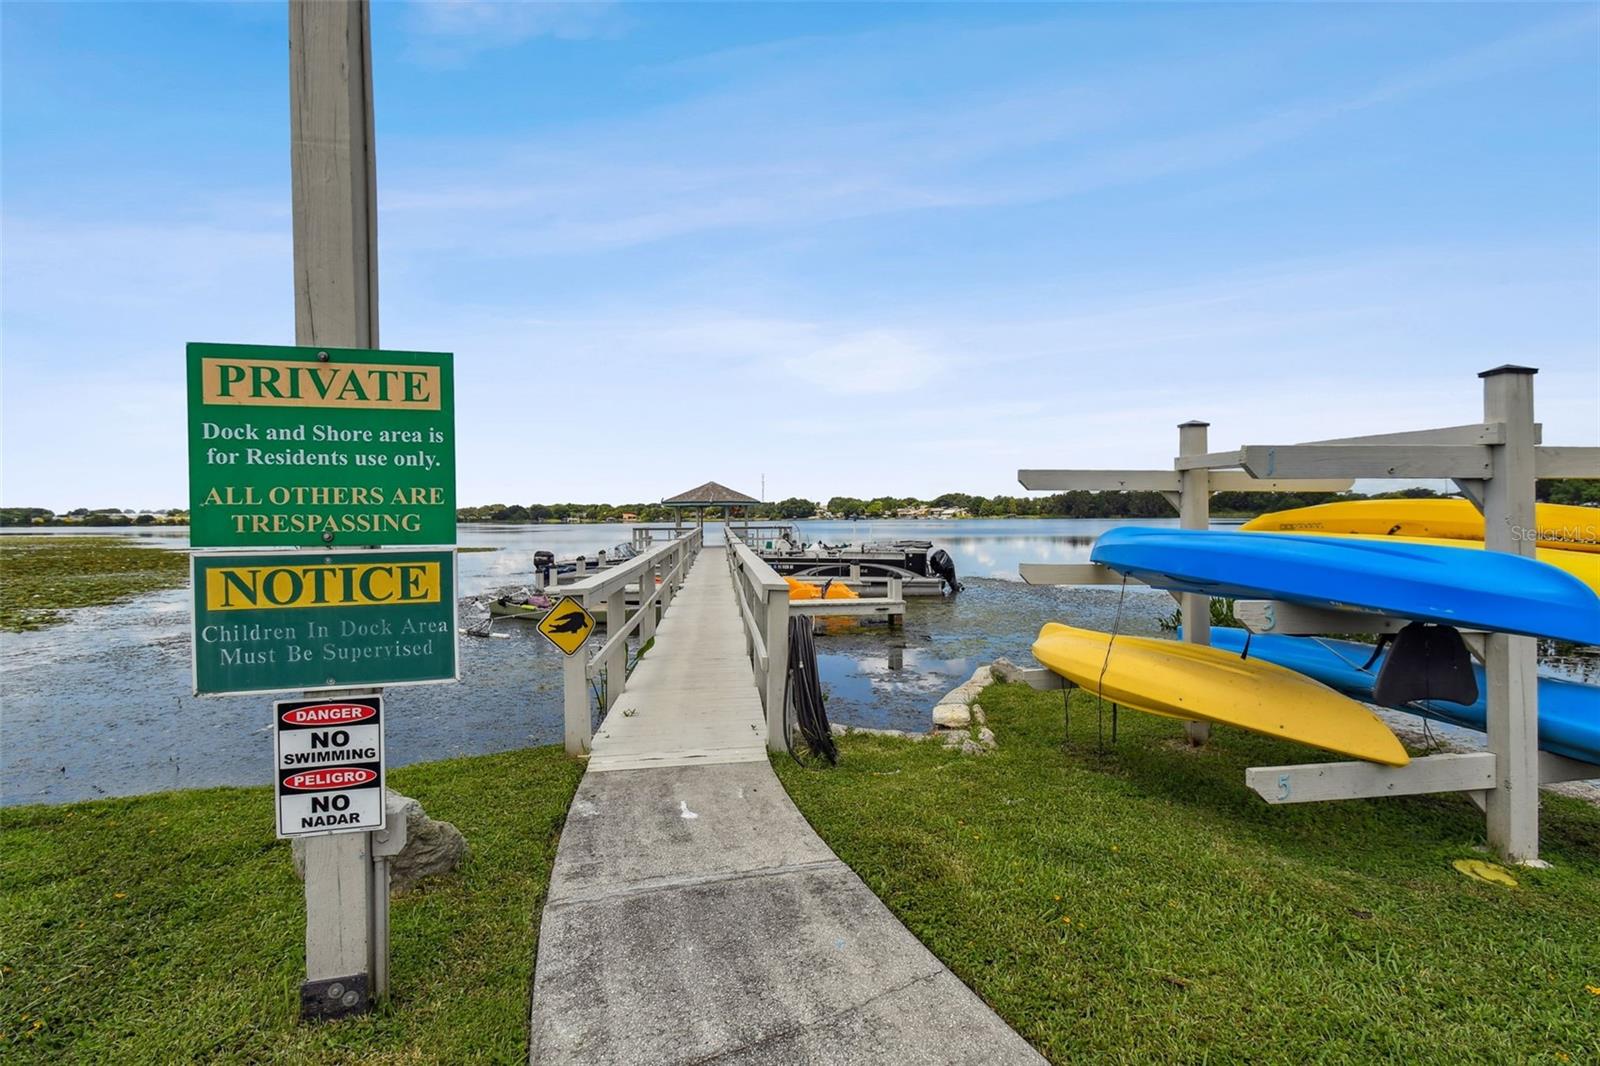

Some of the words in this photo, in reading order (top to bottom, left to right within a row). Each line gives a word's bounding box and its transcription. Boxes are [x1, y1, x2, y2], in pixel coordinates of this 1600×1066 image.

[216, 364, 431, 402] PRIVATE
[202, 422, 259, 441] Dock
[266, 425, 305, 441] and
[312, 425, 373, 443] Shore
[379, 429, 422, 443] area
[429, 427, 444, 444] is
[206, 448, 239, 465] for
[246, 448, 348, 466] Residents
[355, 453, 388, 467] use
[394, 451, 441, 471] only.
[203, 486, 263, 505] ALL
[268, 486, 384, 505] OTHERS
[390, 487, 445, 505] ARE
[231, 514, 421, 534] TRESPASSING
[220, 564, 429, 607] NOTICE
[1261, 603, 1276, 631] 3
[201, 624, 296, 643] Children
[308, 621, 329, 639] In
[340, 618, 393, 637] Dock
[400, 617, 449, 634] Area
[220, 648, 276, 666] Must
[287, 644, 313, 662] Be
[323, 640, 433, 663] Supervised
[295, 707, 363, 722] DANGER
[311, 730, 350, 749] NO
[284, 748, 376, 765] SWIMMING
[294, 770, 367, 786] PELIGRO
[1276, 773, 1291, 801] 5
[311, 794, 351, 813] NO
[301, 812, 361, 828] NADAR
